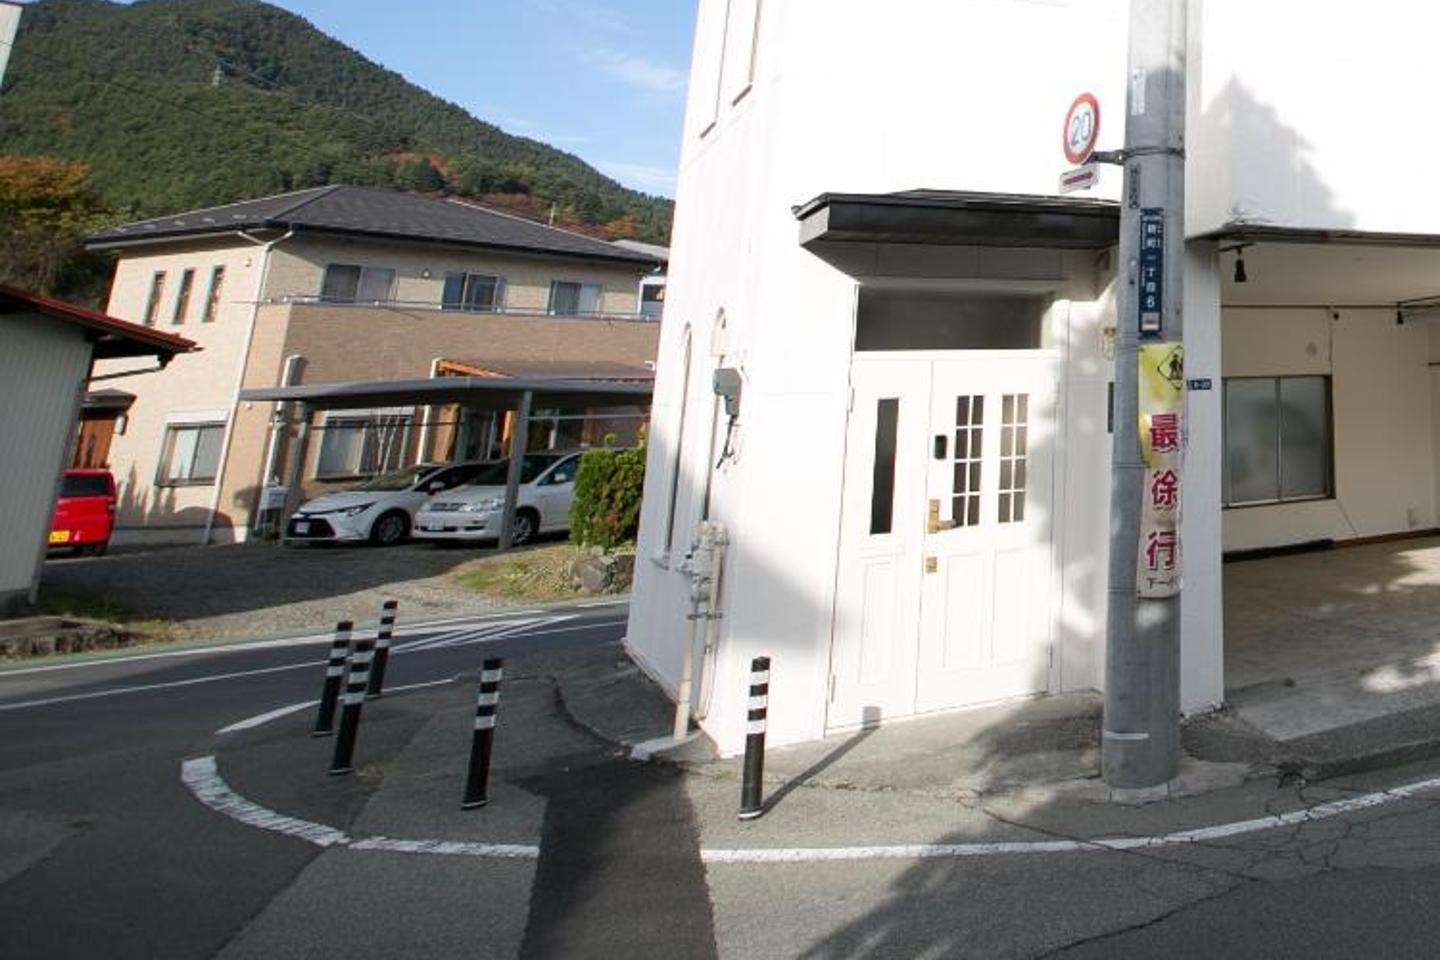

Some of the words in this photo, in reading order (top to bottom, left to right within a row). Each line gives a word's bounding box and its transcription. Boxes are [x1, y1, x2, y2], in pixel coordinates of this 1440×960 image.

[1071, 111, 1091, 145] 20
[1146, 414, 1177, 571] 最徐行
